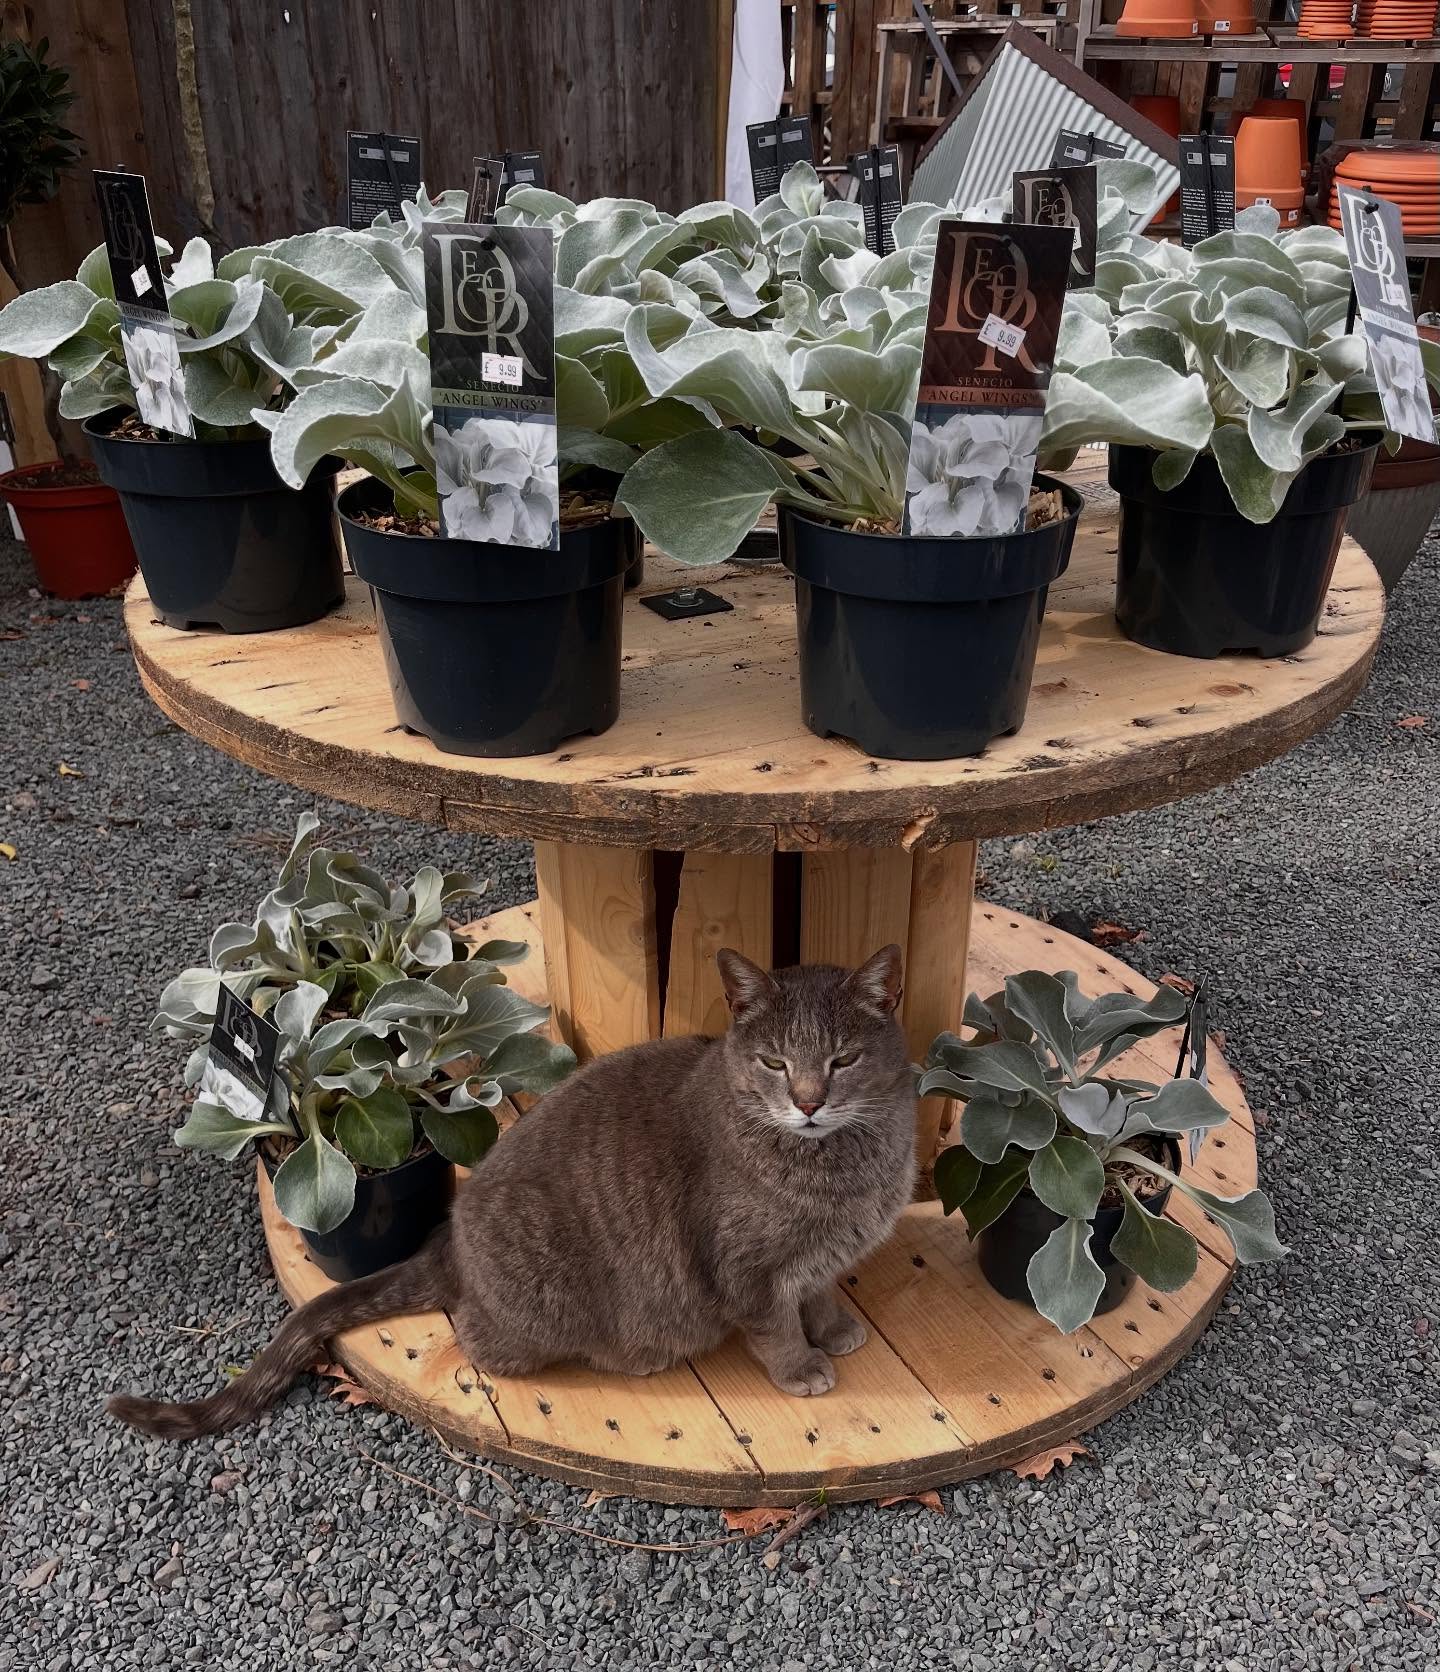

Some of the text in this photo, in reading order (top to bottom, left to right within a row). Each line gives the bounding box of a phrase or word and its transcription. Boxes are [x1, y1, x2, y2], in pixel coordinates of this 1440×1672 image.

[997, 329, 1017, 348] 9.99
[498, 363, 517, 378] 9.99
[958, 377, 1013, 388] SENECIO
